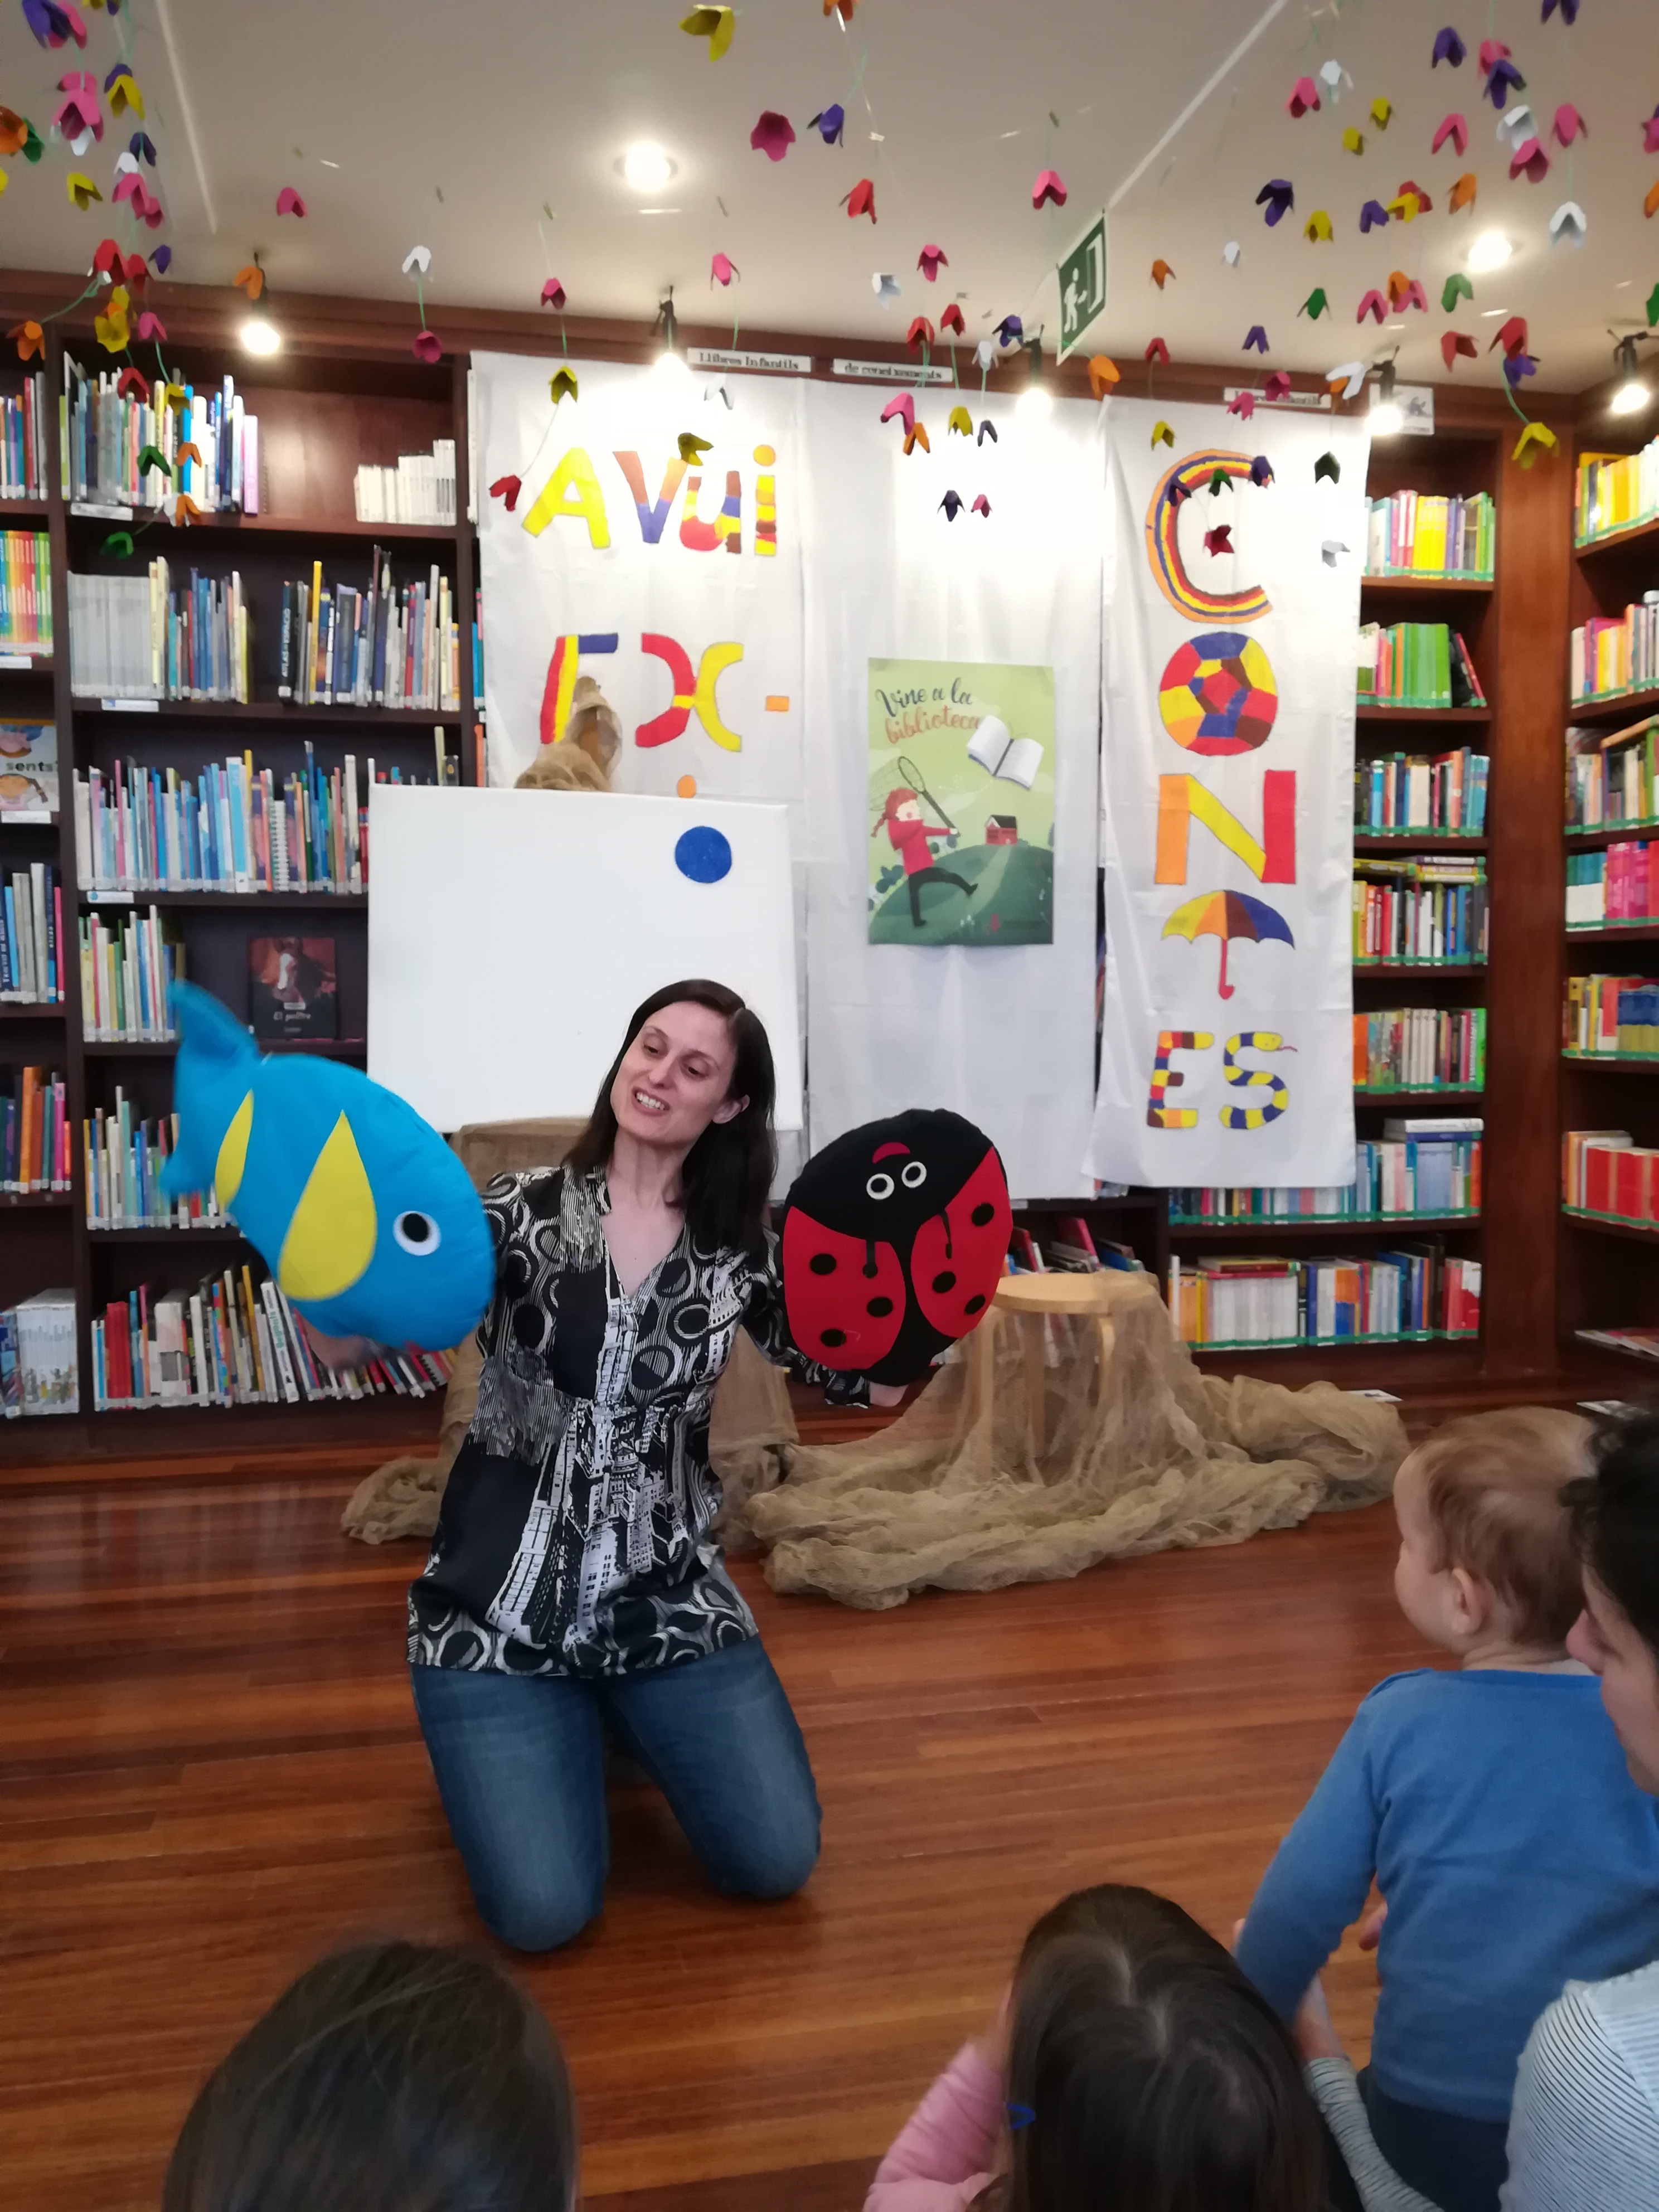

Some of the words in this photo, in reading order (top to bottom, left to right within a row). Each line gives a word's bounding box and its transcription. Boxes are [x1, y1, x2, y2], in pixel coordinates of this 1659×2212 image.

[745, 356, 799, 370] Infantils
[844, 362, 859, 373] de
[875, 688, 928, 717] Vine
[932, 687, 947, 701] a
[950, 677, 974, 705] la
[885, 704, 980, 744] biblioteca
